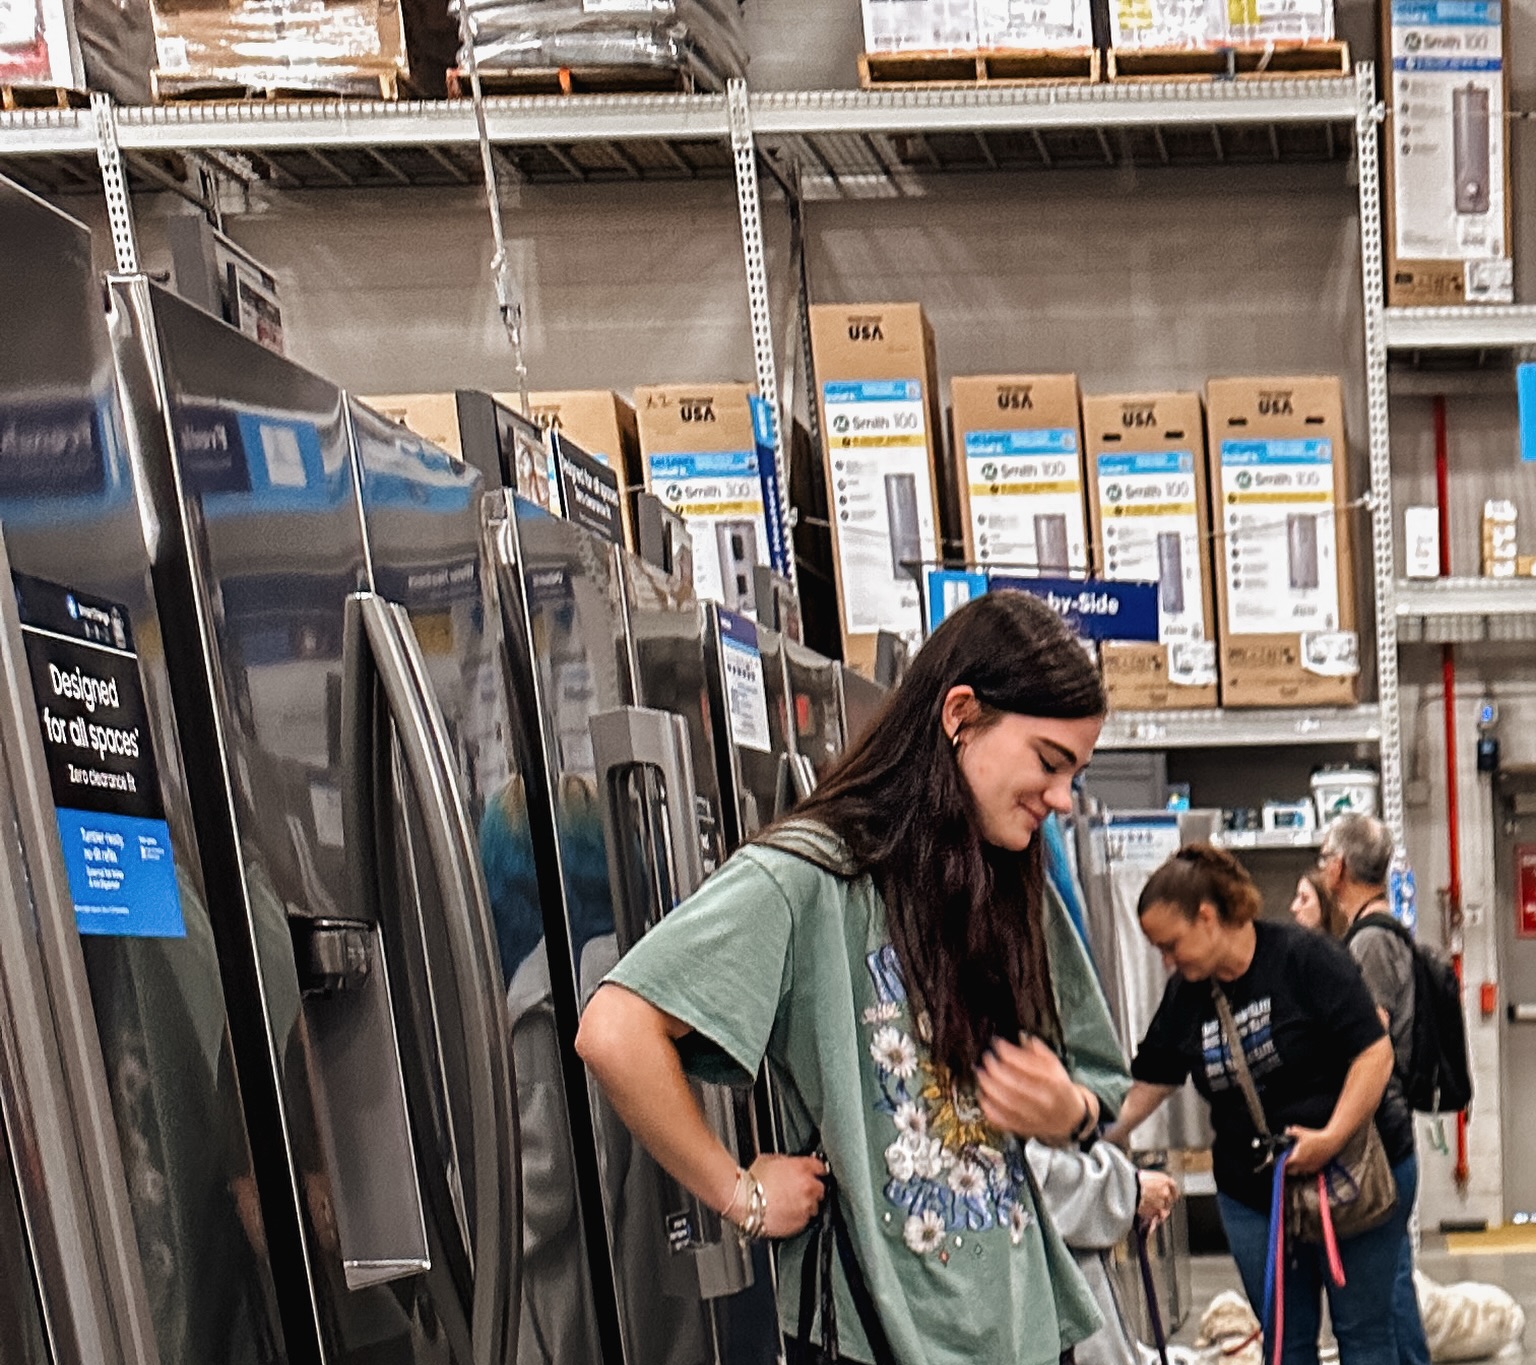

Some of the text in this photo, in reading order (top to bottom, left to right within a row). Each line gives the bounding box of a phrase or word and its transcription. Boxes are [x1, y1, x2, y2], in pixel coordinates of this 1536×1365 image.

[848, 325, 884, 341] USA
[997, 392, 1034, 410] USA
[680, 405, 716, 422] USA
[49, 662, 120, 713] Designed
[44, 706, 68, 745] for
[69, 715, 89, 748] all
